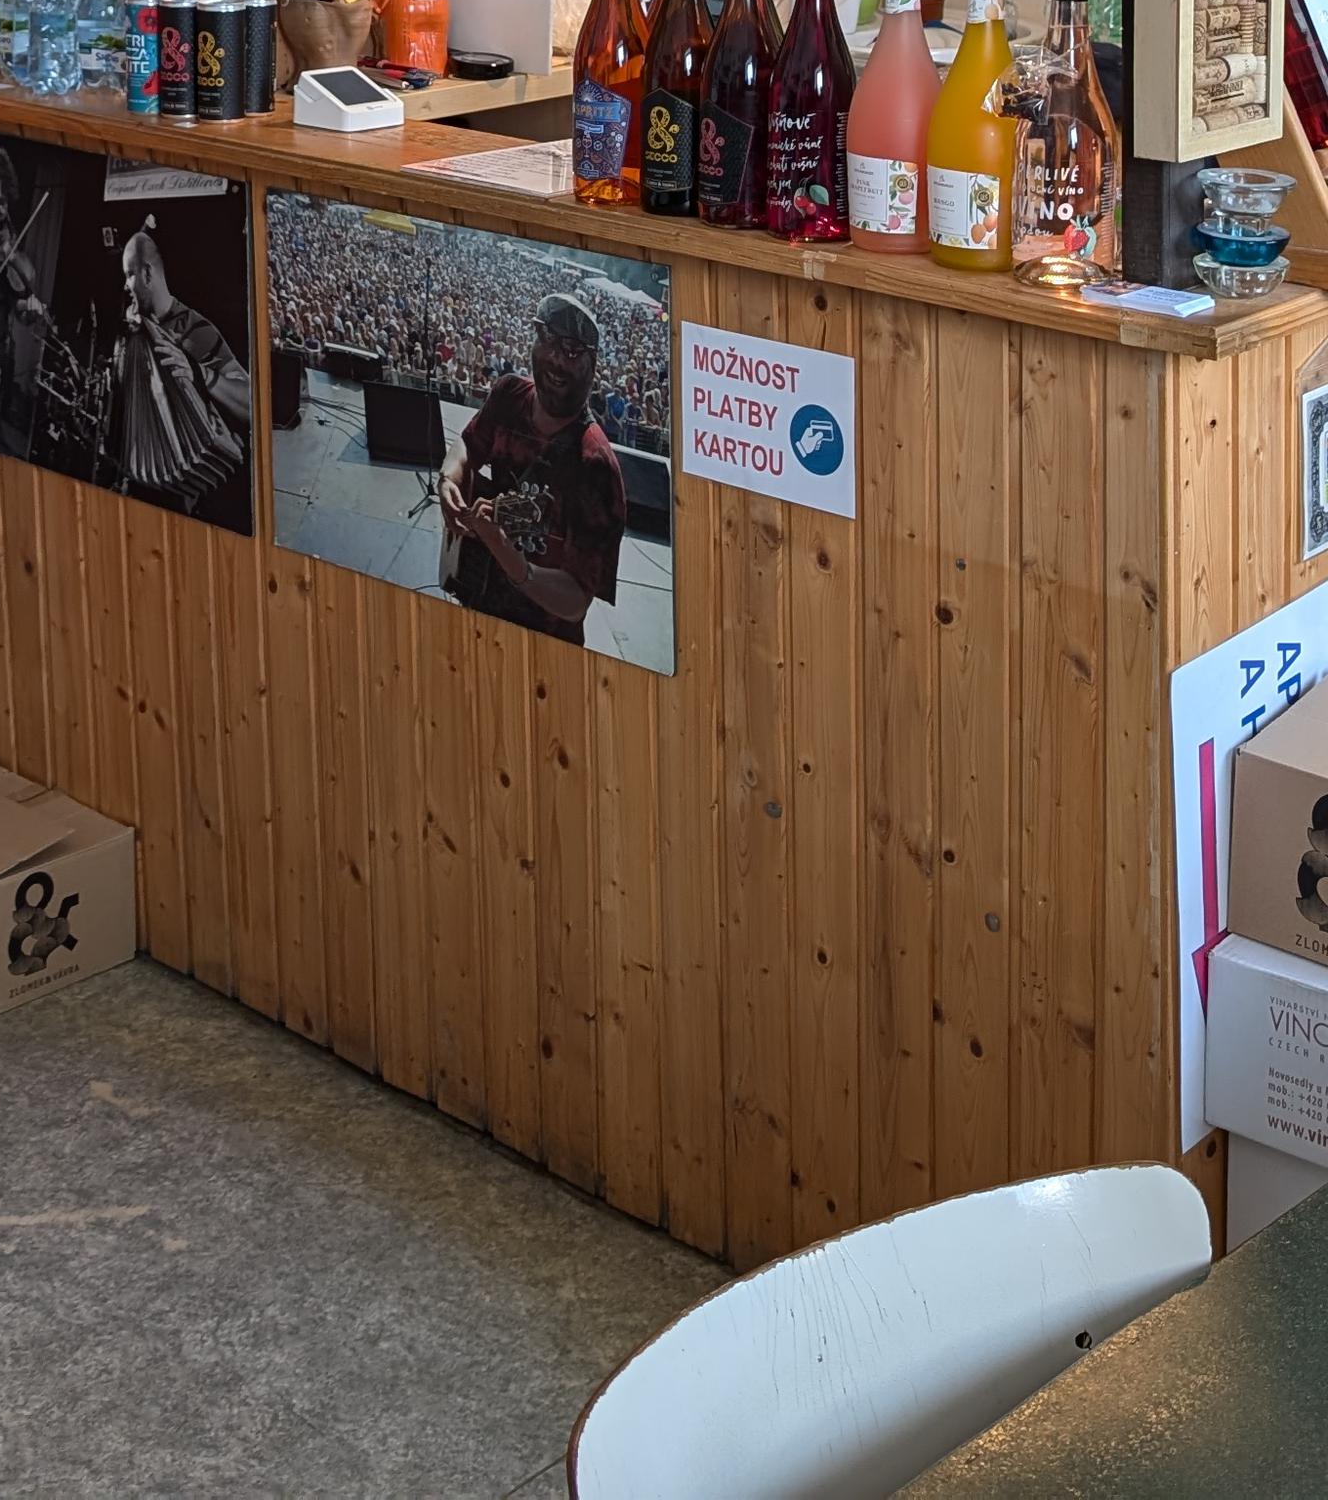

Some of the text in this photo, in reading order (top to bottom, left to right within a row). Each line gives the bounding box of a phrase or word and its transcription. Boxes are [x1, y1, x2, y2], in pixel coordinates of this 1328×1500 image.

[693, 344, 800, 394] MOŽNOST
[693, 387, 778, 431] PLATBY
[694, 428, 784, 477] KARTOU
[1240, 660, 1265, 698] A
